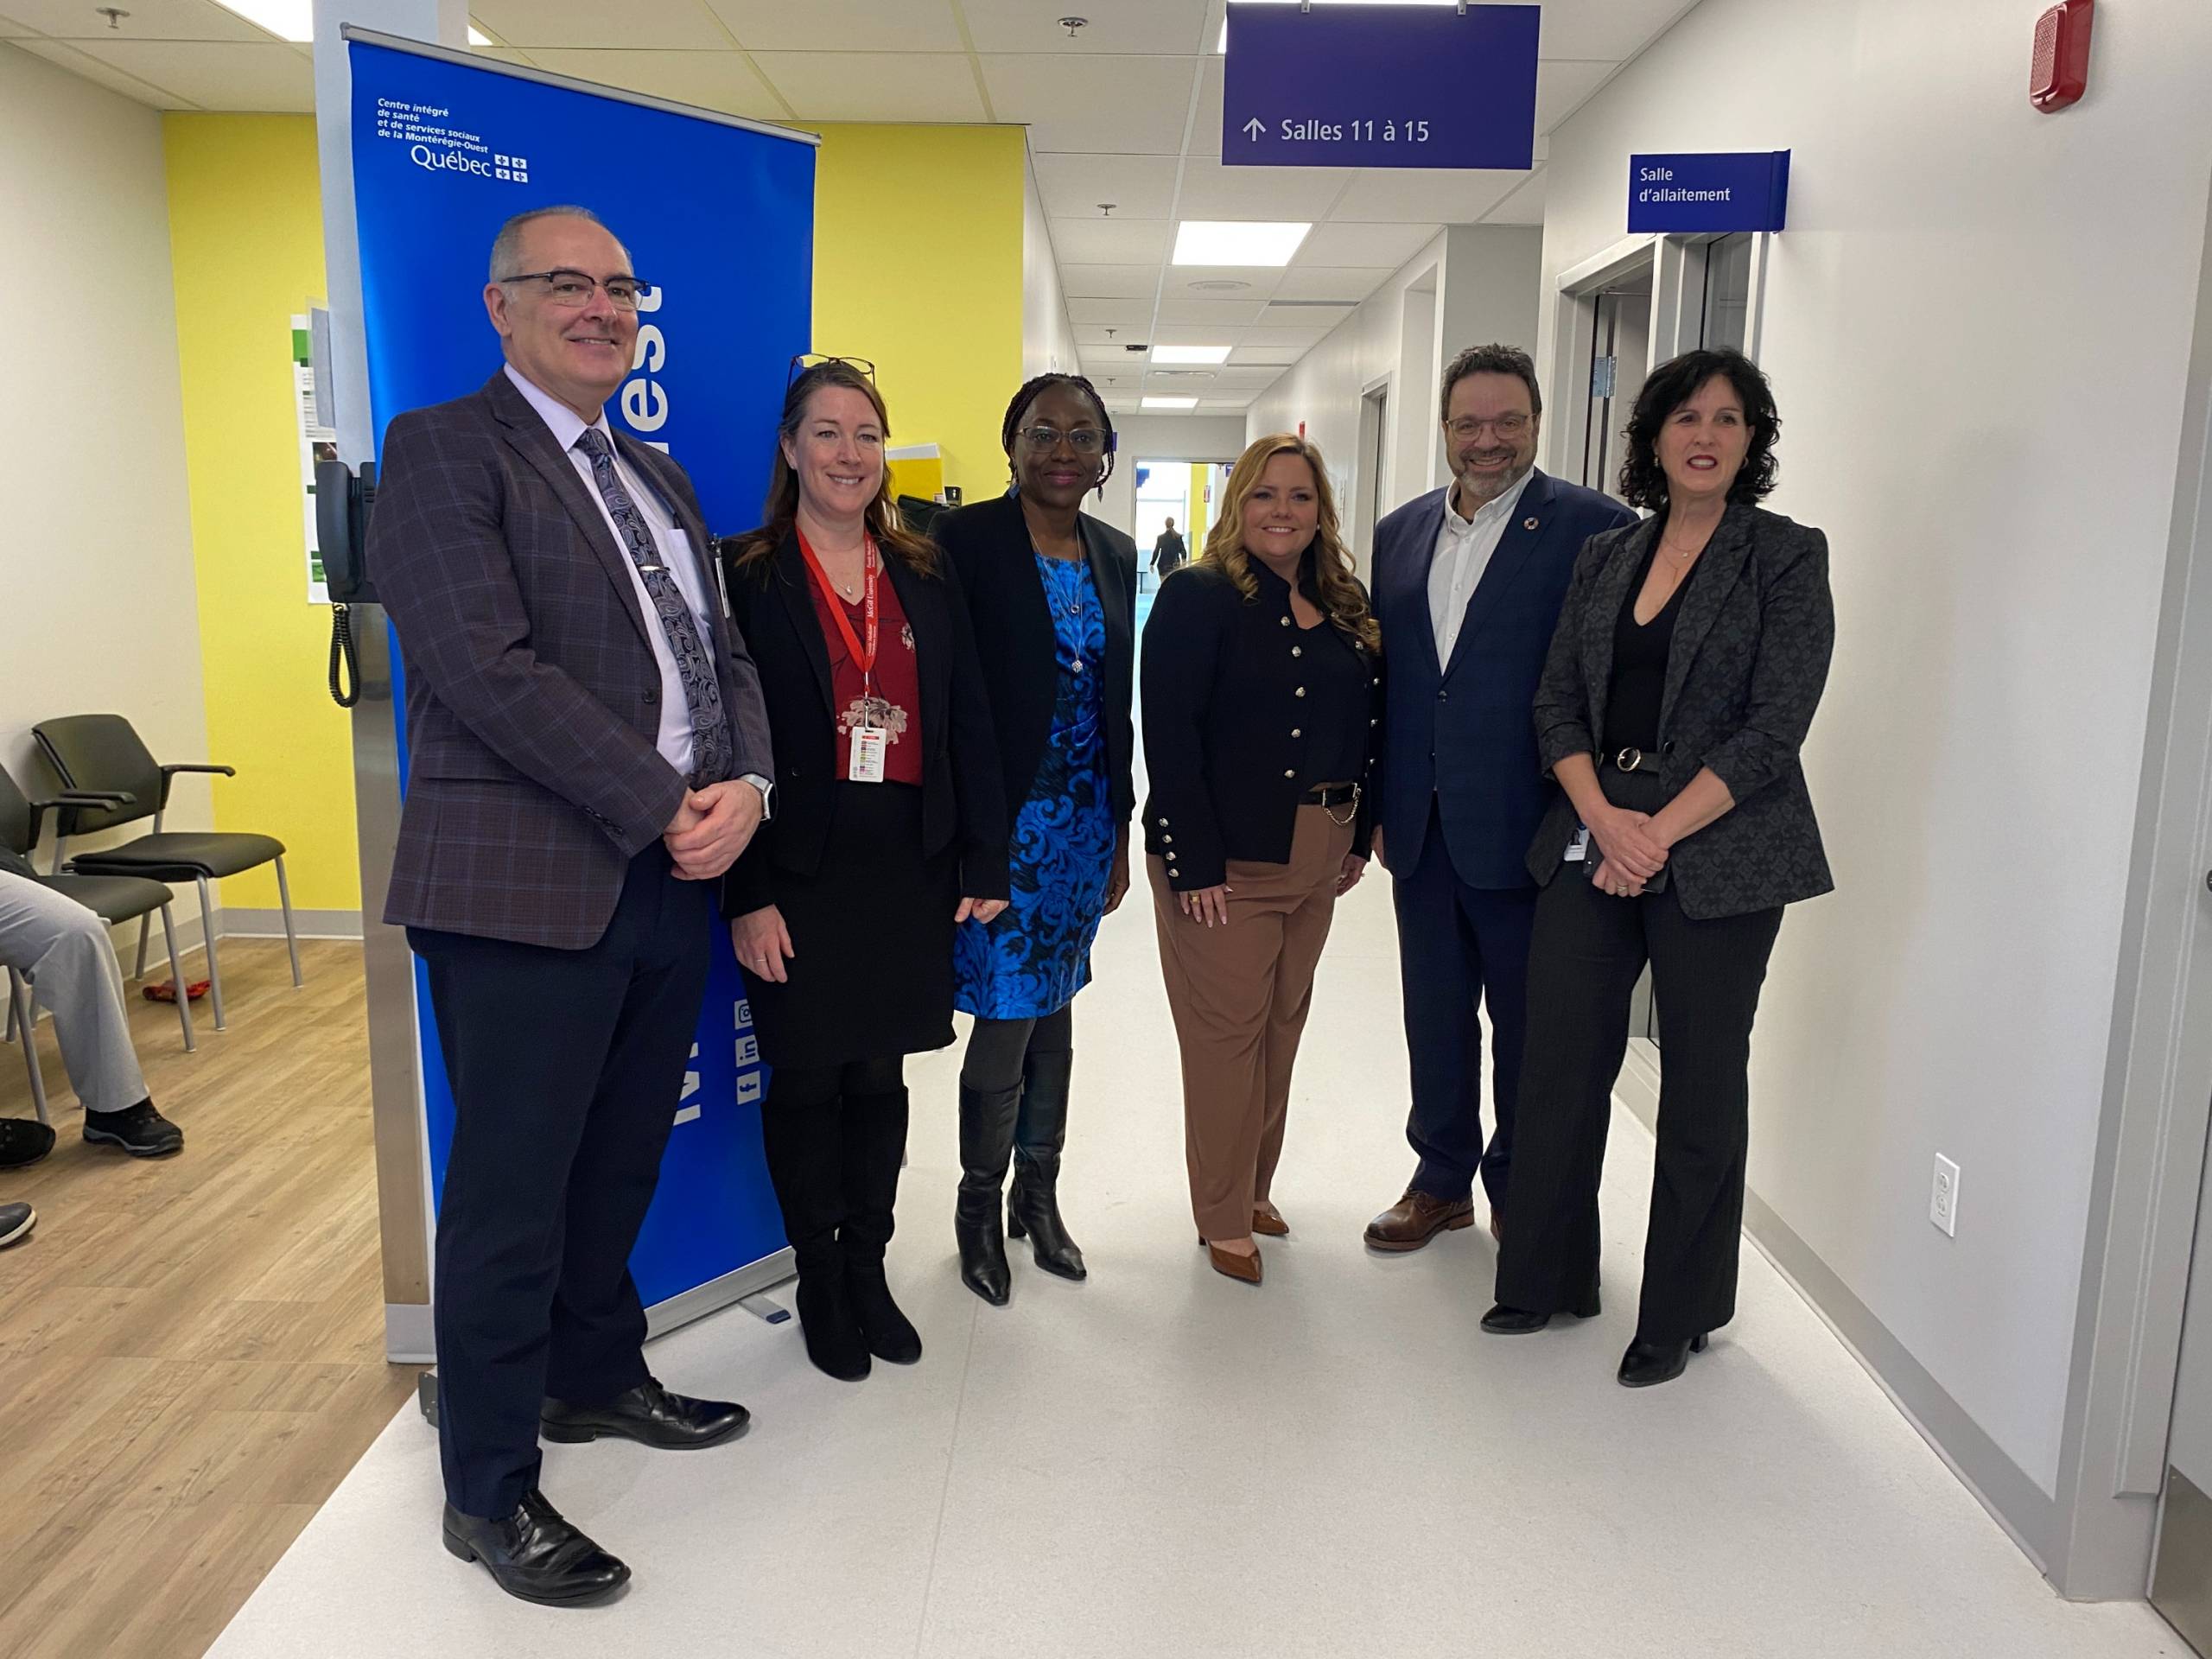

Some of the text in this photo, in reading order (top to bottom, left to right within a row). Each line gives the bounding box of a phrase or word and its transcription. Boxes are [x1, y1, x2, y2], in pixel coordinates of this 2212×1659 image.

[378, 98, 449, 118] Centre intégré
[378, 109, 420, 123] de santé
[378, 119, 480, 143] et de services sociaux
[378, 129, 489, 154] de la Montérégie-Ouest
[1281, 118, 1429, 142] Salles 11 à 15
[410, 144, 492, 177] Québec
[1640, 167, 1674, 181] Salle
[1638, 188, 1731, 202] d’allaitement
[620, 286, 669, 454] est
